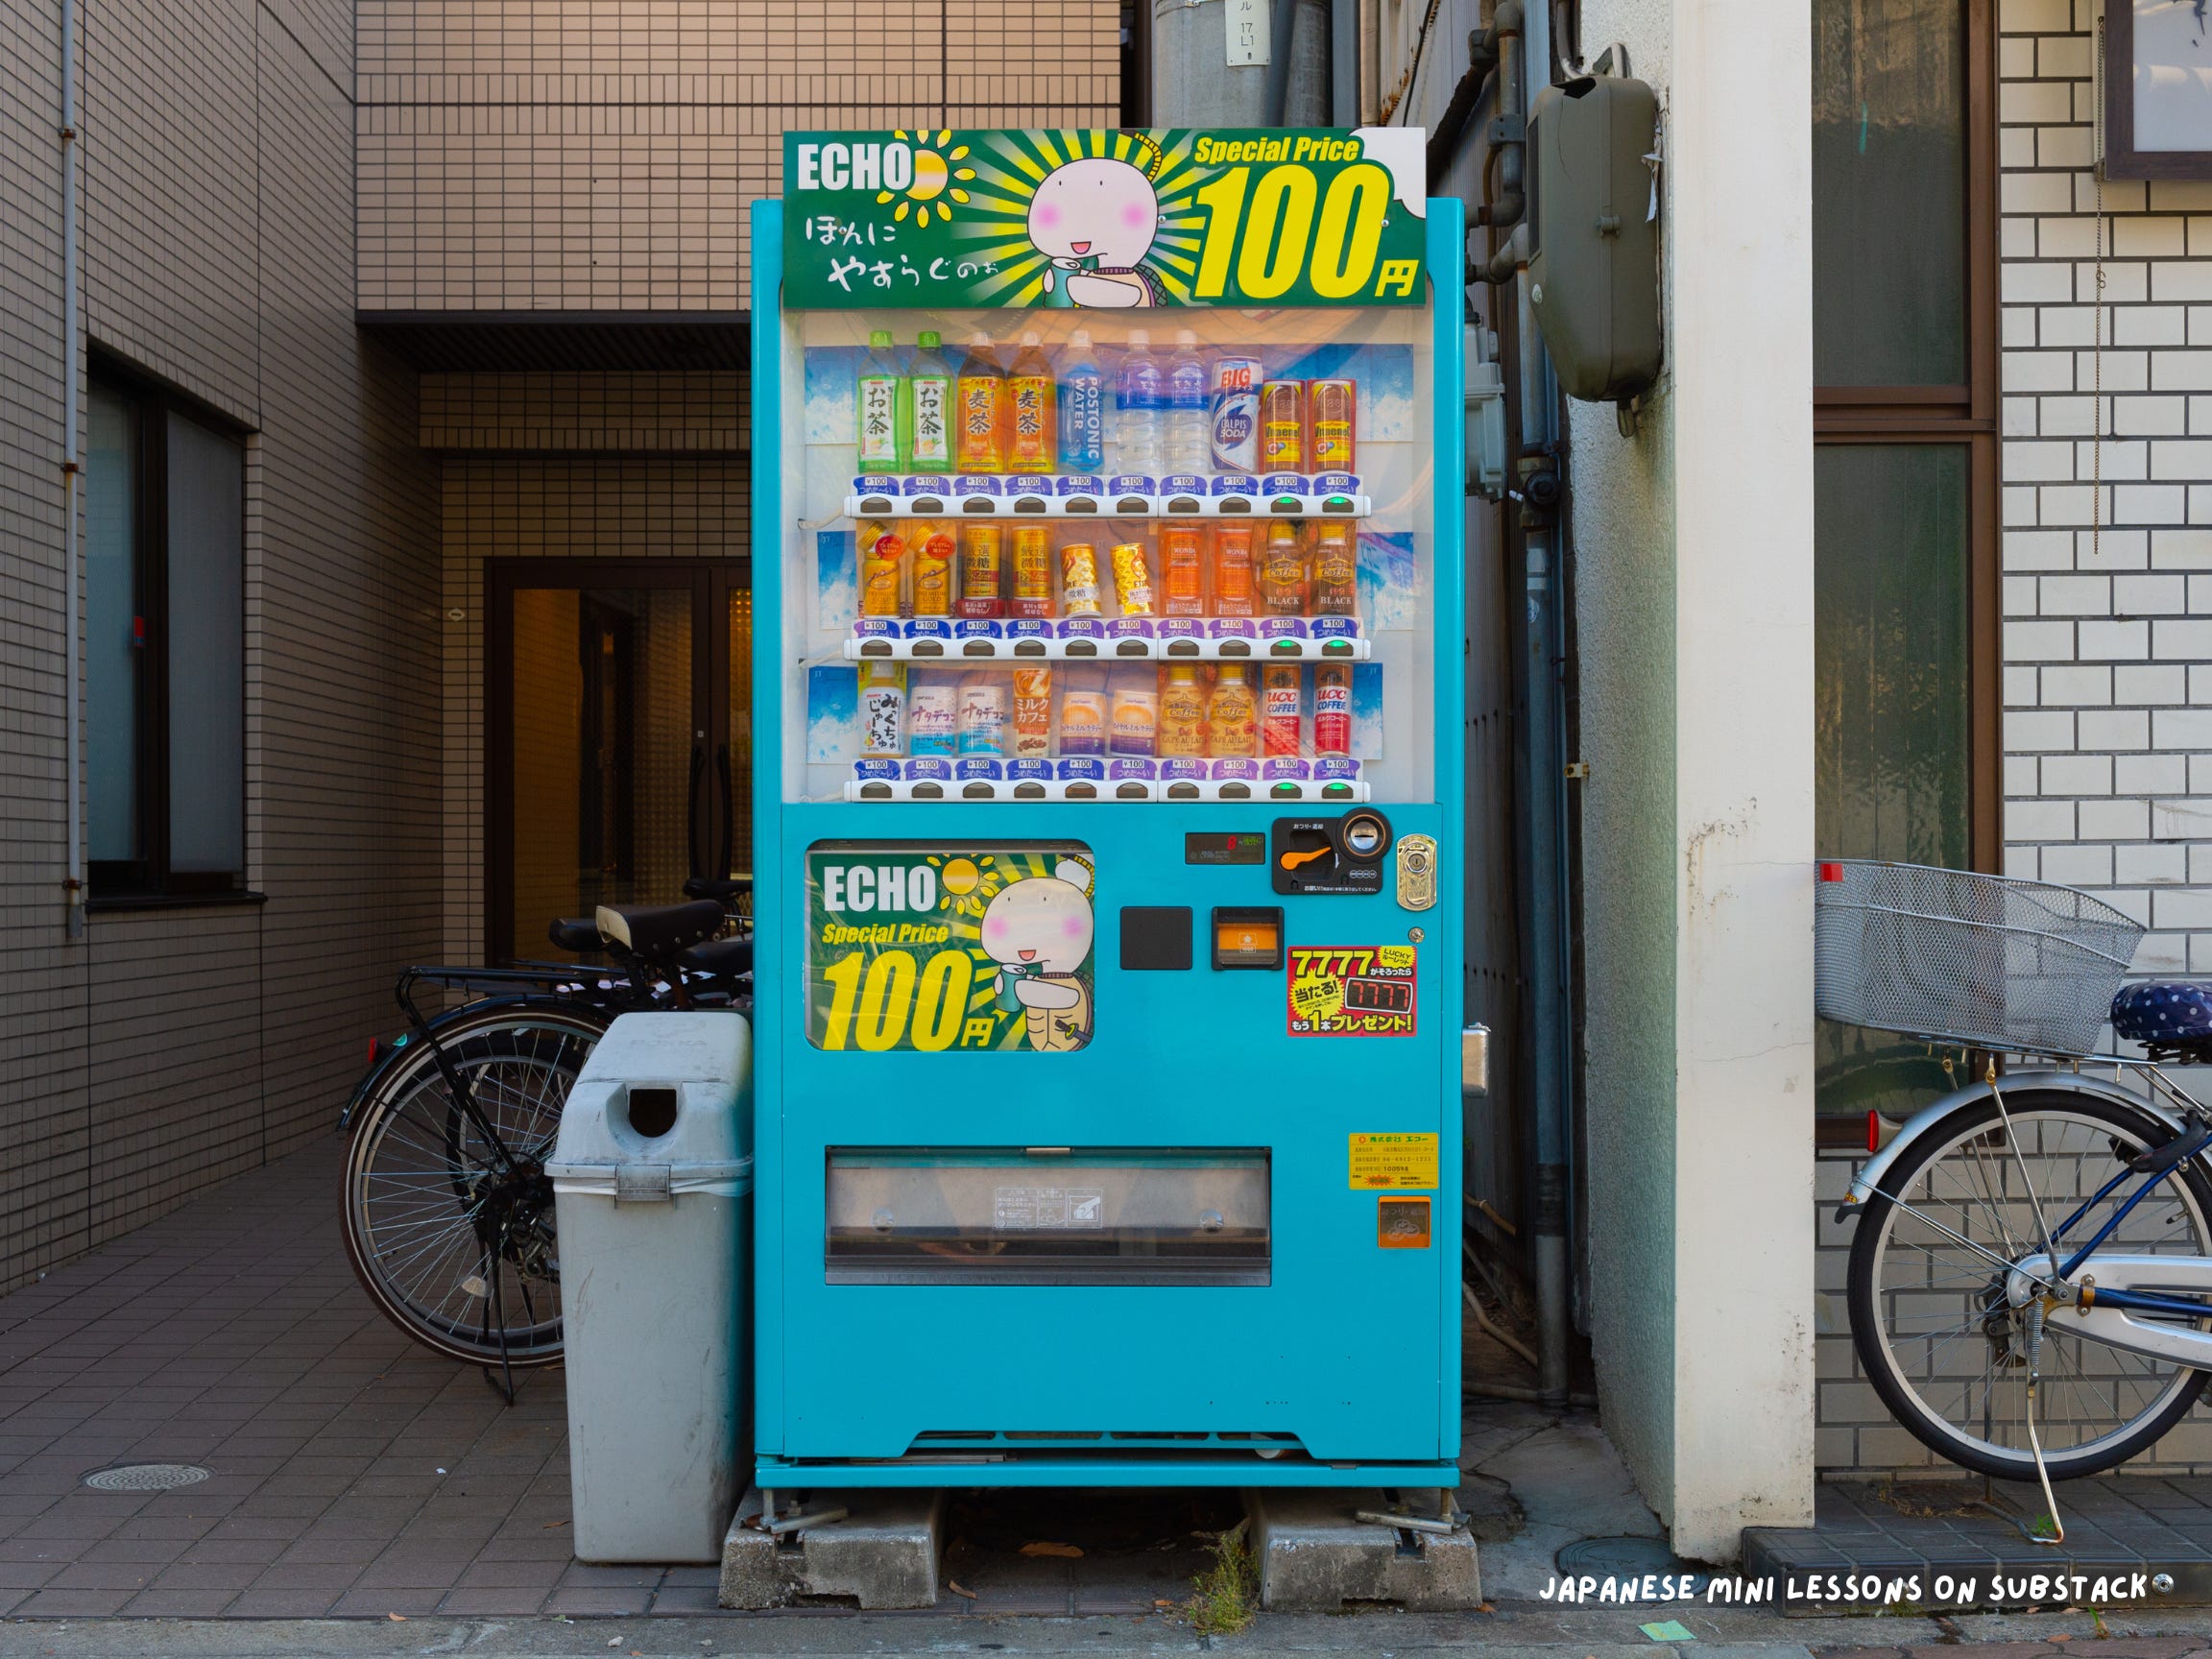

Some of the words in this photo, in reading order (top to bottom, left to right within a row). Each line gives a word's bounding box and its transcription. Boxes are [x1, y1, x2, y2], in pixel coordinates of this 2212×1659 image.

[1241, 23, 1253, 34] 17
[1241, 36, 1253, 46] L1
[1194, 136, 1291, 165] Special
[1292, 136, 1359, 162] Price
[797, 142, 912, 190] ECHO
[805, 215, 896, 246] ほんに
[1221, 368, 1251, 388] BIG
[1073, 377, 1085, 430] WATER
[864, 387, 889, 435] お茶
[917, 387, 942, 435] お茶
[967, 389, 991, 435] 麦茶
[1018, 389, 1041, 435] 麦茶
[1087, 376, 1100, 460] POSTONIC
[1220, 420, 1247, 430] CALPIS
[1220, 429, 1246, 439] SODA
[1269, 567, 1299, 577] Coffee
[1267, 596, 1300, 605] BLACK
[1320, 596, 1352, 605] BLACK
[1267, 692, 1297, 702] UCC
[1317, 689, 1346, 700] UCC
[1017, 698, 1048, 710] ミルク
[1267, 704, 1297, 712] COFFEE
[1317, 701, 1346, 709] COFFEE
[1018, 711, 1047, 723] カフェ
[1169, 709, 1200, 717] Coffee
[870, 699, 887, 748] じゅーちゅ
[880, 693, 898, 750] みっくちゅ
[824, 865, 937, 912] ECHO
[823, 924, 894, 945] Special
[899, 924, 949, 943] Price
[1382, 955, 1409, 964] ルーレット
[1384, 949, 1411, 958] LUCKY
[1292, 950, 1374, 975] 7777
